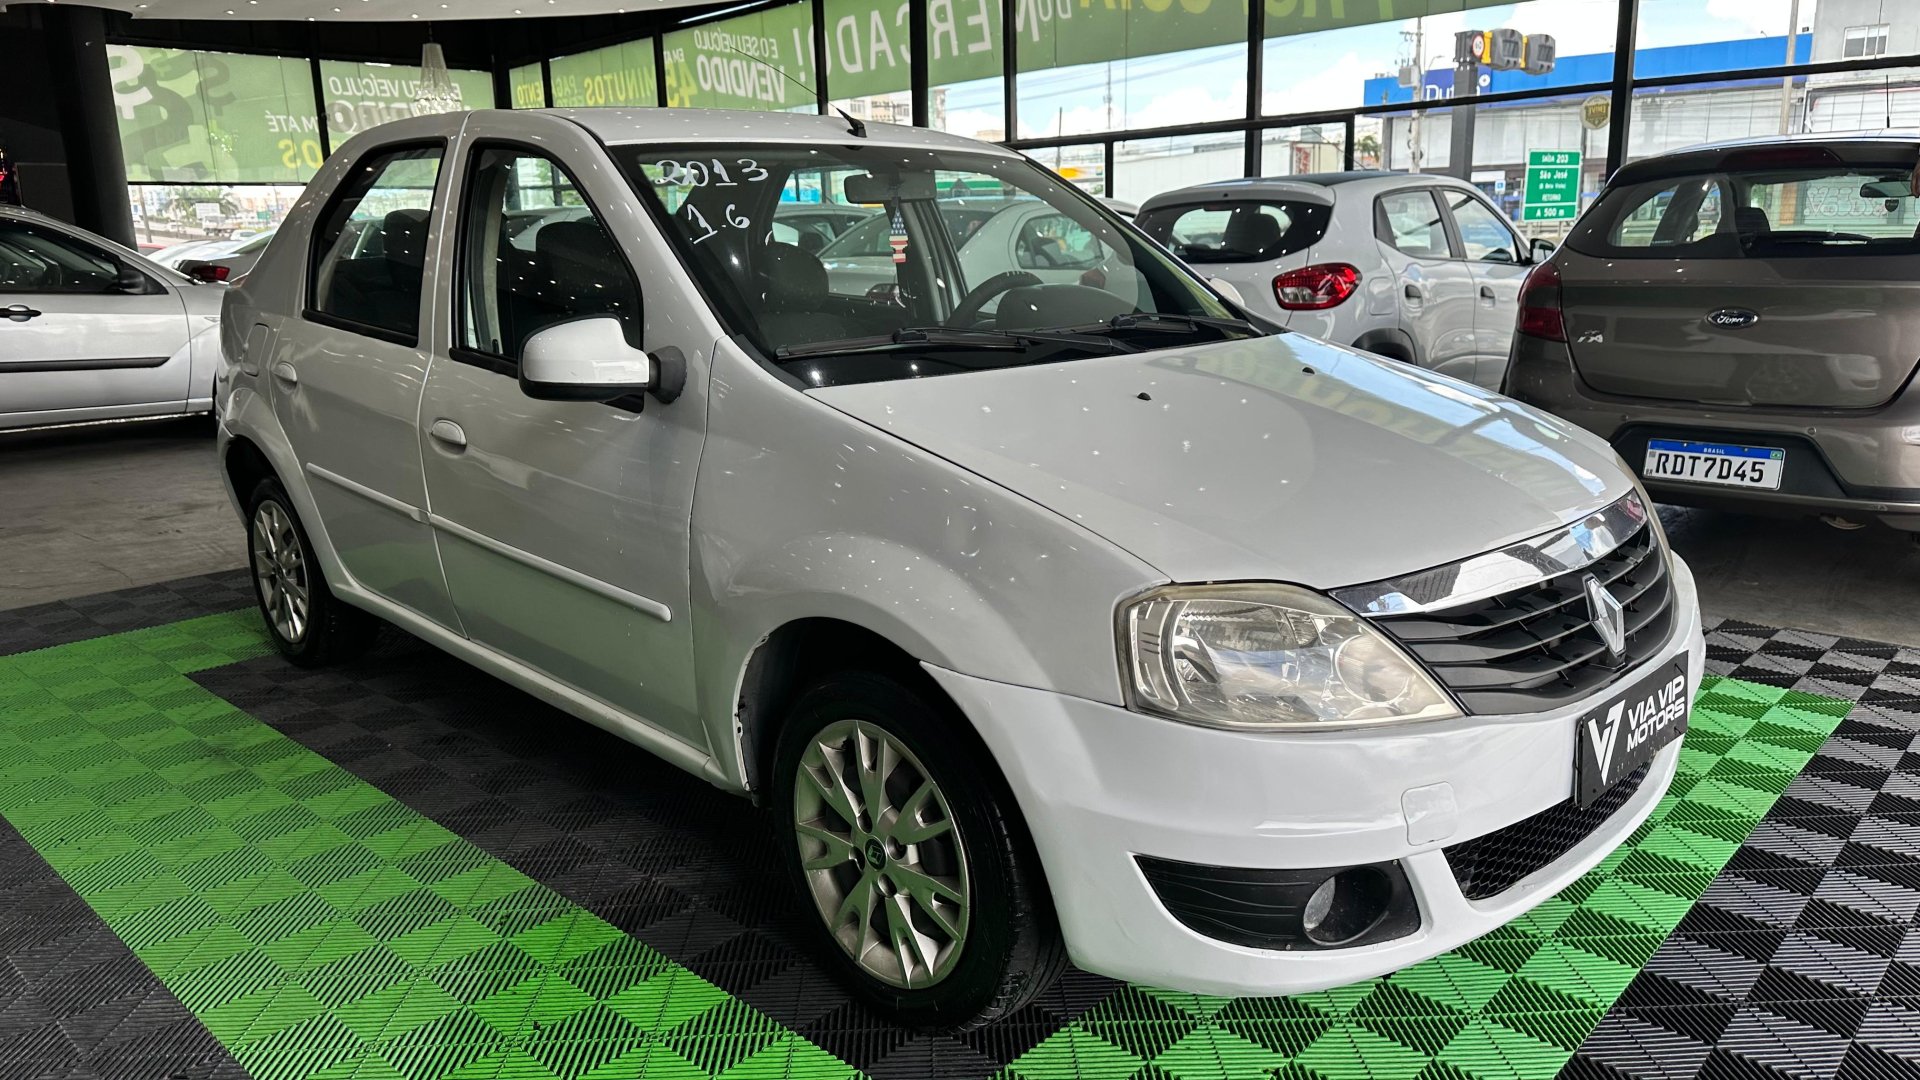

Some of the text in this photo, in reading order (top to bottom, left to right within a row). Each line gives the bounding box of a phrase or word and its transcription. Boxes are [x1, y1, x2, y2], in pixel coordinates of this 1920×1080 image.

[655, 158, 769, 187] 2013
[687, 204, 751, 244] 1.6
[1544, 208, 1557, 217] 500
[1703, 447, 1725, 455] BRASIL
[1655, 452, 1766, 484] RDT7D45
[1627, 675, 1685, 731] VIA VIP
[1626, 696, 1685, 753] MOTORS
